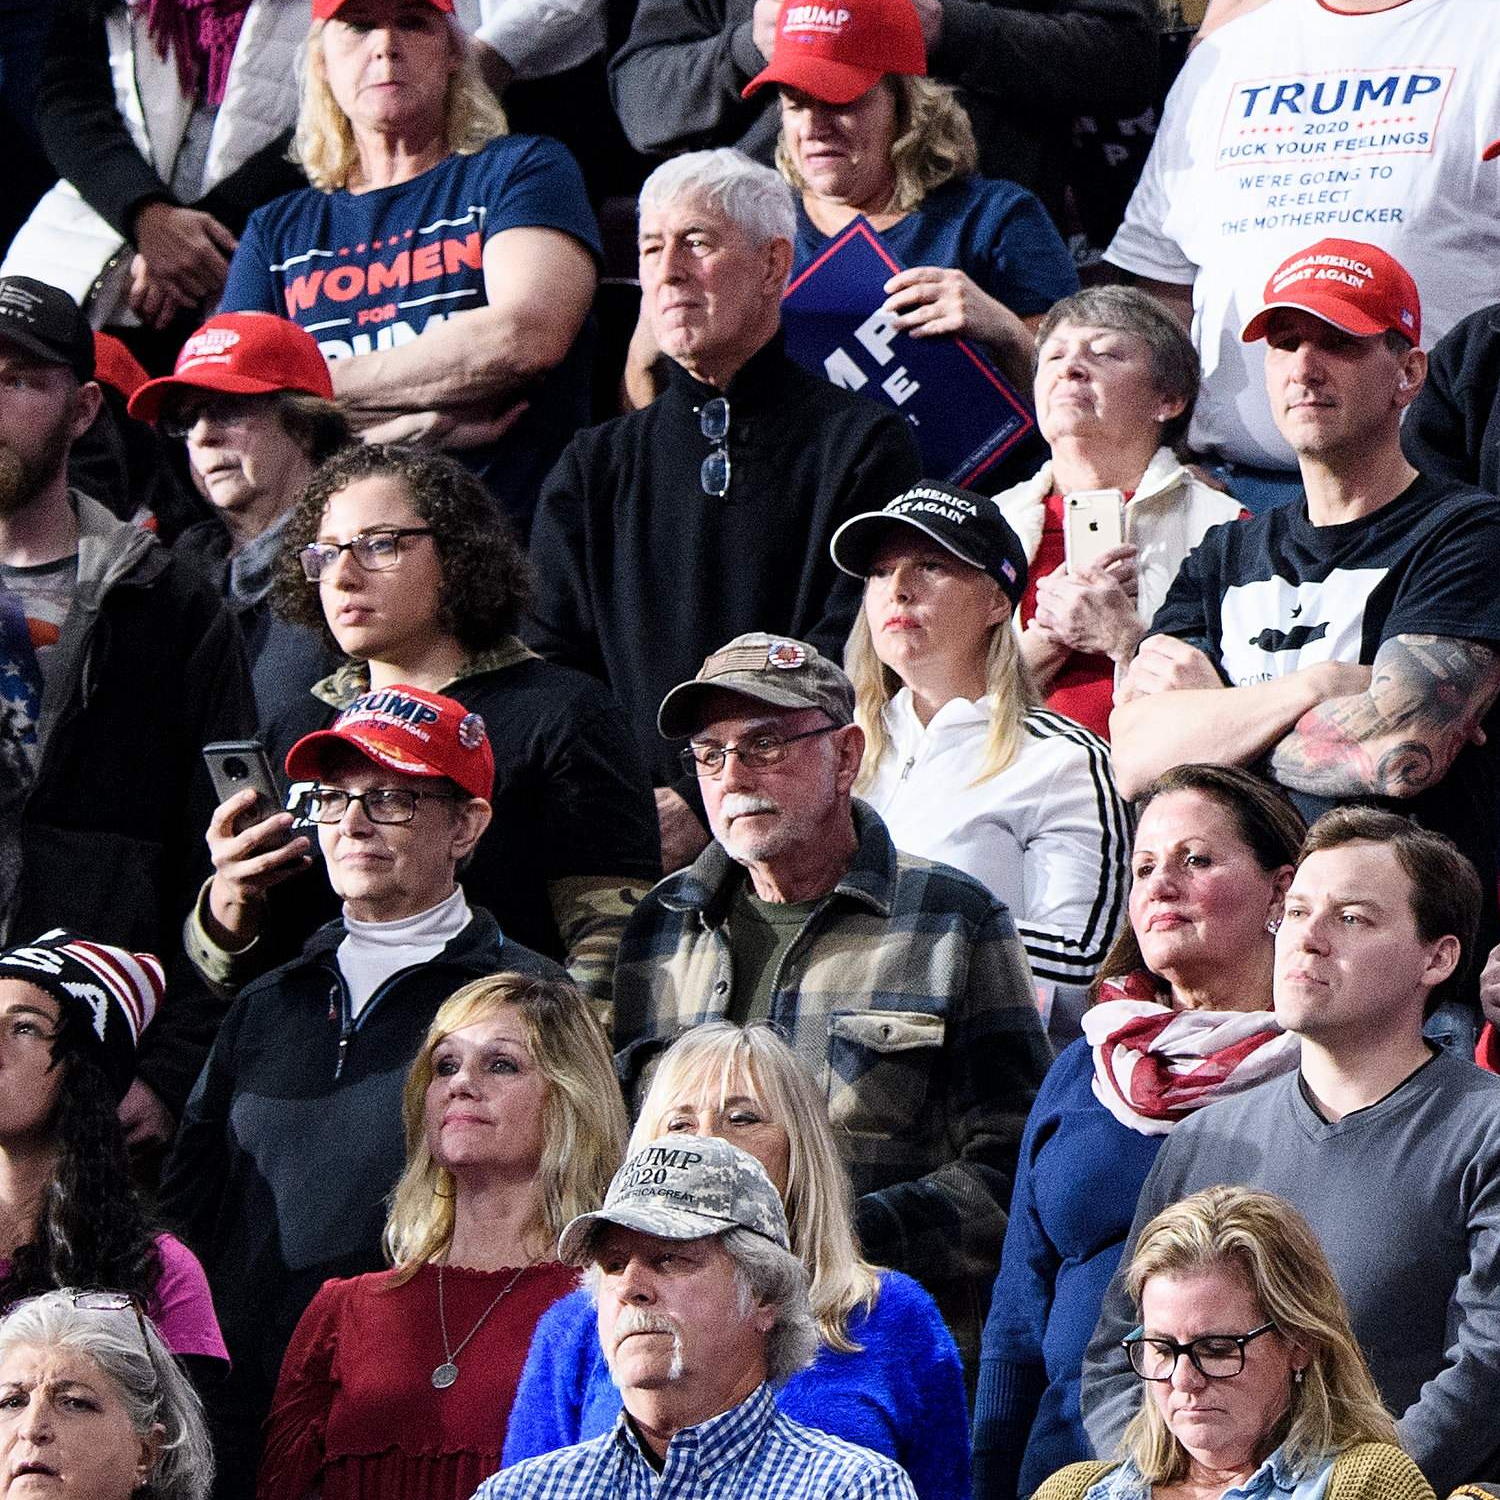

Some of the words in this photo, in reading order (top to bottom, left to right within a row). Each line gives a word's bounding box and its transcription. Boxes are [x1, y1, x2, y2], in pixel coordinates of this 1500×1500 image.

[785, 5, 849, 27] TRUMP
[1240, 75, 1440, 119] TRUMP
[1303, 119, 1350, 136] 2020
[1219, 141, 1262, 161] FUCK
[1266, 137, 1328, 156] YOUR
[1333, 131, 1431, 153] FEELINGS
[1238, 172, 1292, 191] WE'RE
[1299, 167, 1359, 185] GOING
[1368, 165, 1393, 180] TO
[1266, 188, 1353, 210] RE-ELECT
[1220, 217, 1250, 237] THE
[1256, 207, 1405, 231] MOTHERFUCKER
[284, 231, 482, 318] WOMEN
[1302, 255, 1375, 280] AMERICA
[1314, 269, 1365, 289] AGAIN
[357, 304, 398, 326] FOR
[317, 312, 450, 362] RUM
[901, 487, 978, 517] AMERICA
[911, 503, 967, 525] AGAIN
[626, 1147, 702, 1178] RUMP
[619, 1168, 667, 1192] 2020
[657, 1187, 695, 1204] GREAT
